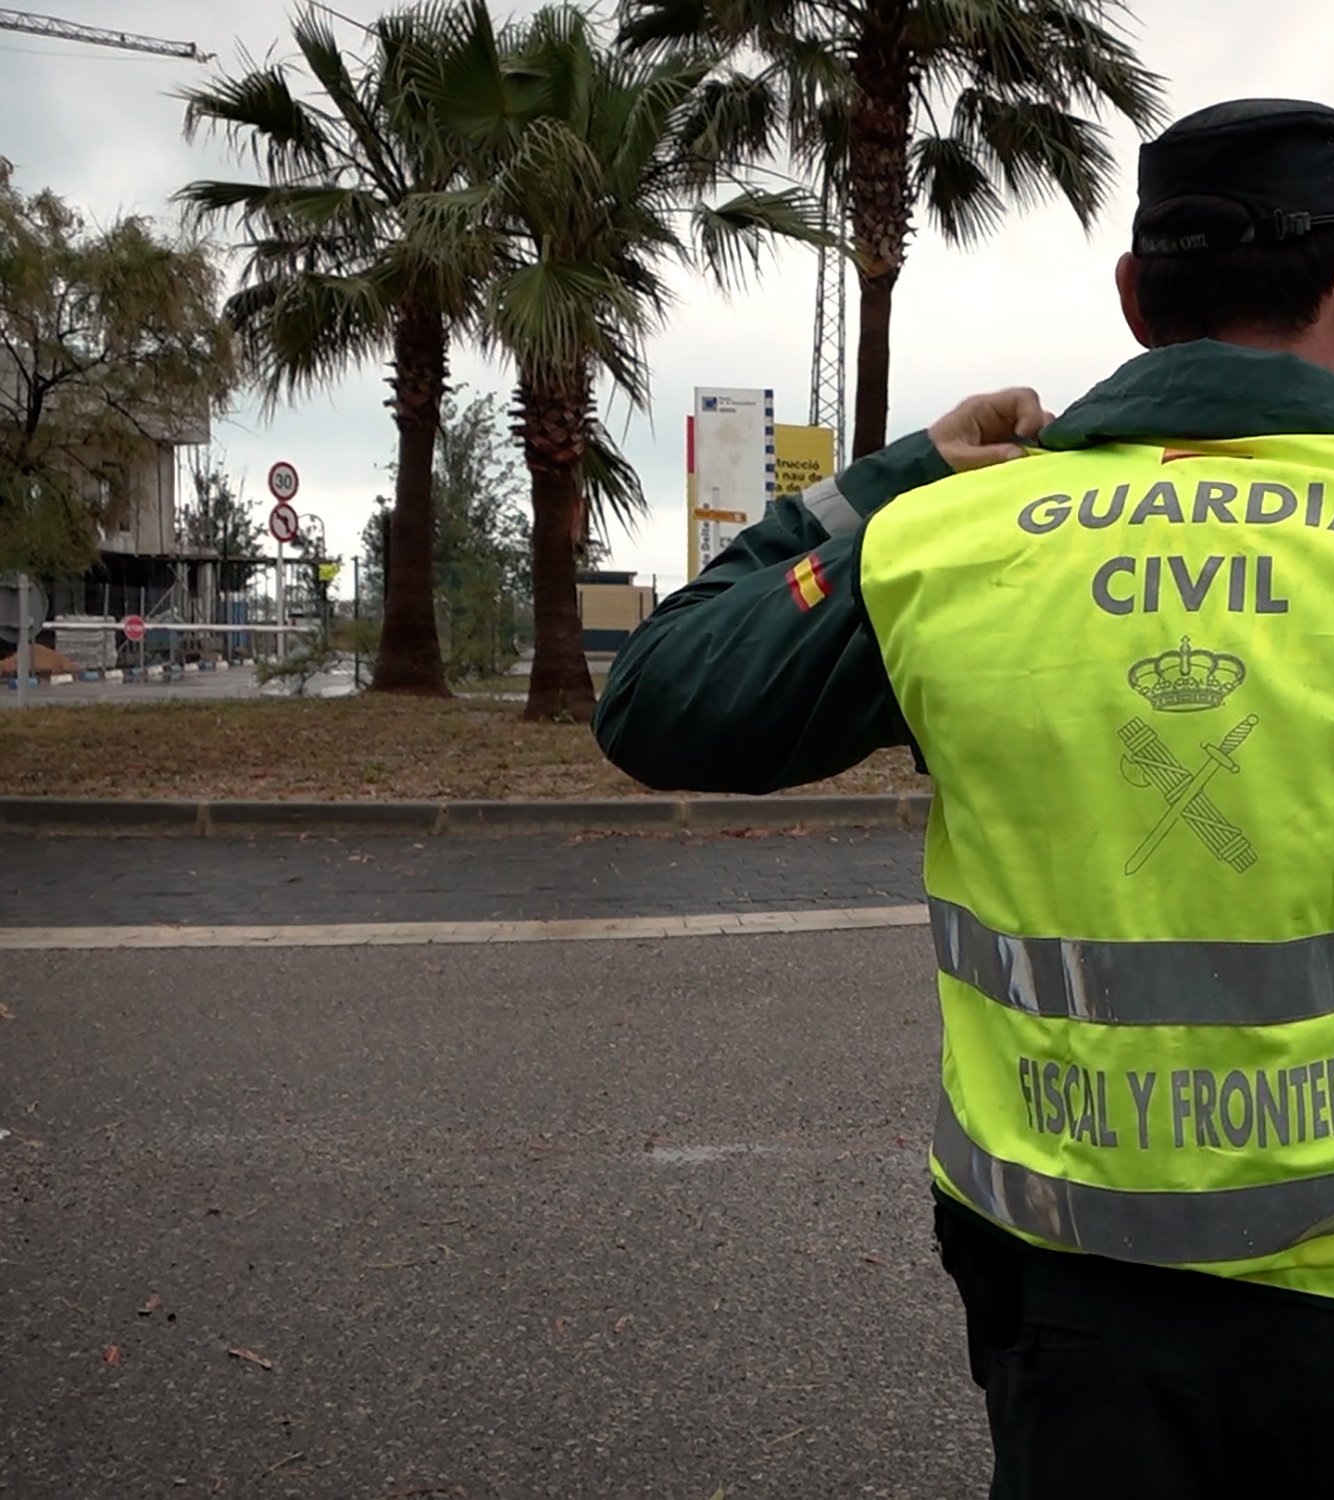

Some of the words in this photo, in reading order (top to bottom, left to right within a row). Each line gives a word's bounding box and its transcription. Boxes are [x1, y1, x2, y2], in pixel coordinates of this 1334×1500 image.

[275, 473, 292, 489] 30
[1091, 555, 1289, 616] CIVIL
[1018, 1056, 1118, 1148] FISCAL
[1127, 1071, 1156, 1149] Y
